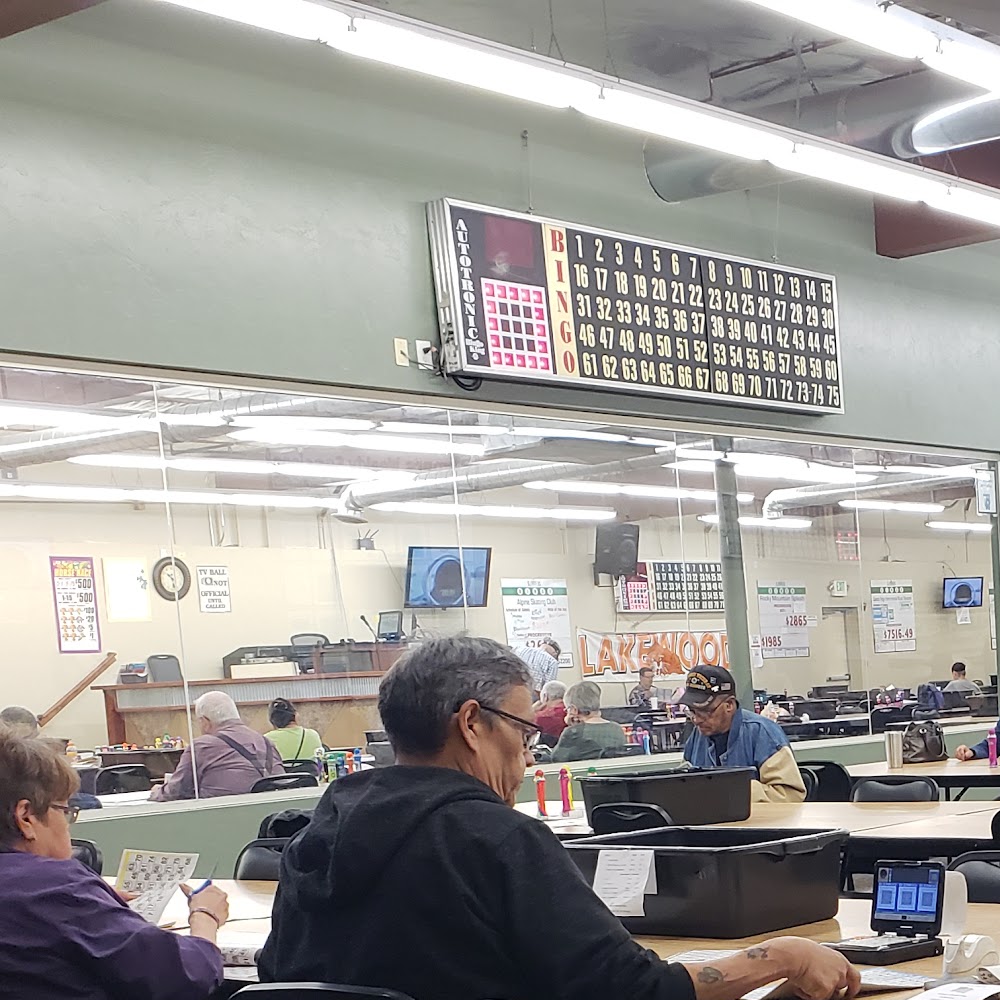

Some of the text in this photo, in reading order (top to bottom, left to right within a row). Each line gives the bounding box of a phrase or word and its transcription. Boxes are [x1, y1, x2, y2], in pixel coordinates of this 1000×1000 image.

[456, 218, 479, 340] AUTOTRONIC
[574, 264, 834, 330] 16 17 18 19 20 21 22 23 24 25 26 27 28 29 30
[575, 234, 832, 304] 1 2 3 4 5 6 7 8 9 10 11 12 13 14 15
[550, 228, 575, 374] BINGO
[576, 293, 835, 355] 31 32 33 34 35 36 37 38 39 40 41 42 43 44 45
[579, 323, 837, 381] 46 47 48 49 50 51 52 53 54 55 56 57 58 59 60
[582, 352, 598, 376] 61
[602, 355, 619, 379] 62
[622, 357, 638, 381] 63
[640, 360, 656, 383] 64
[659, 362, 674, 386] 65
[678, 365, 692, 388] 66
[696, 367, 709, 390] 67
[715, 370, 729, 394] 68
[732, 372, 746, 395] 69
[748, 375, 762, 397] 70
[765, 377, 778, 398] 71
[780, 379, 794, 401] 72
[826, 385, 840, 406] 75
[762, 636, 782, 647] $1985
[786, 616, 807, 626] $2865
[884, 628, 913, 639] $7516.49
